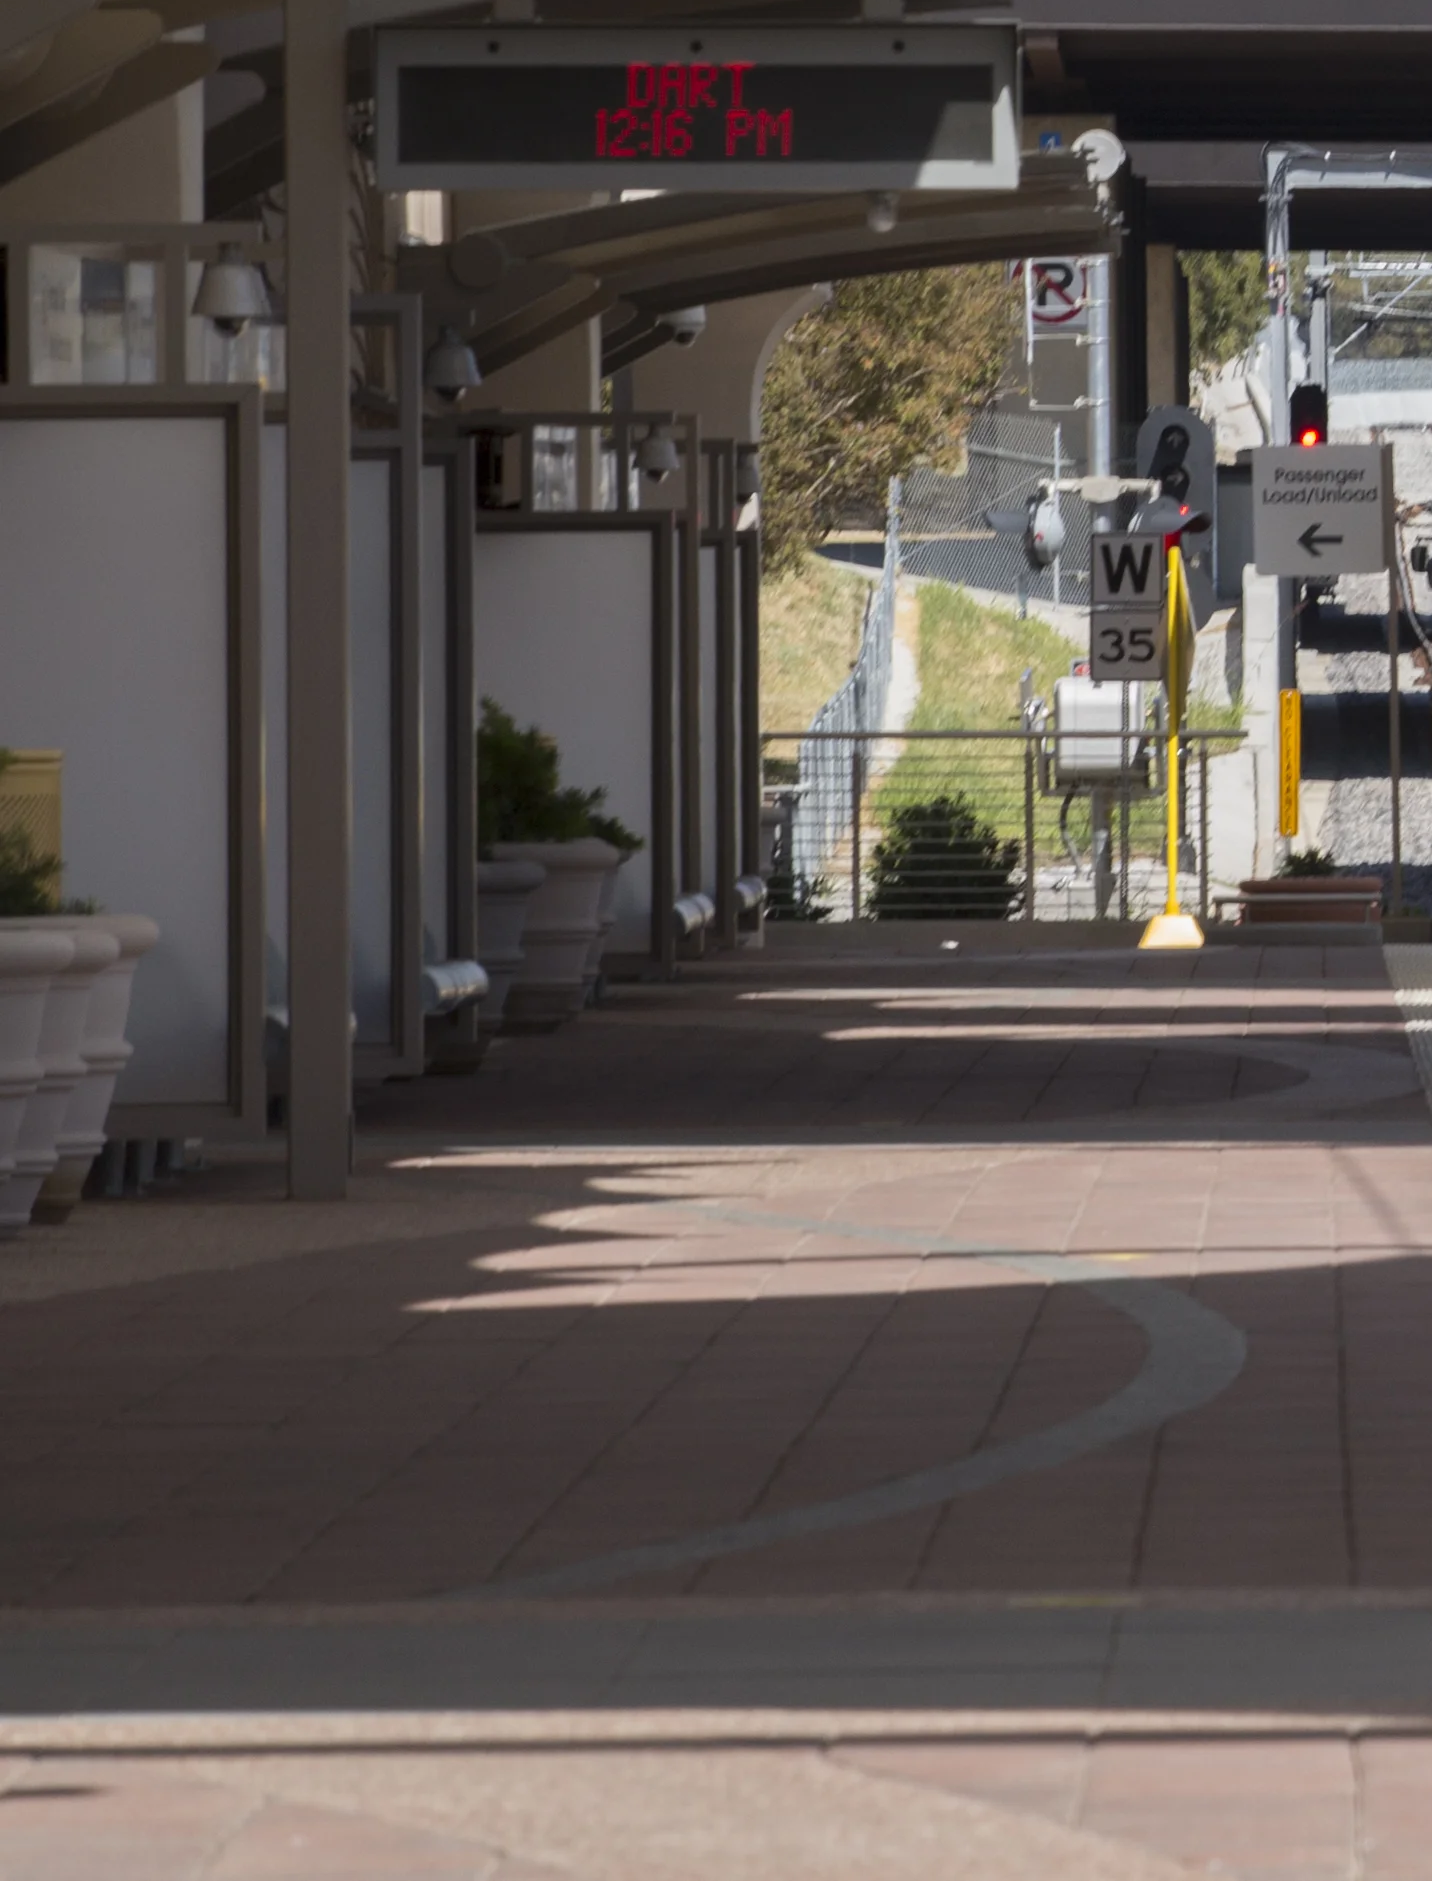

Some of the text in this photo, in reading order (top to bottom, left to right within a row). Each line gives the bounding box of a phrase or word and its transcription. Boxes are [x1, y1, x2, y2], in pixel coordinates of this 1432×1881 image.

[626, 60, 757, 108] DART
[595, 108, 793, 157] 12:16 PM
[1262, 487, 1379, 504] Load/Unload
[1274, 467, 1366, 485] Passenger
[1100, 542, 1154, 595] W
[1098, 628, 1156, 663] 35
